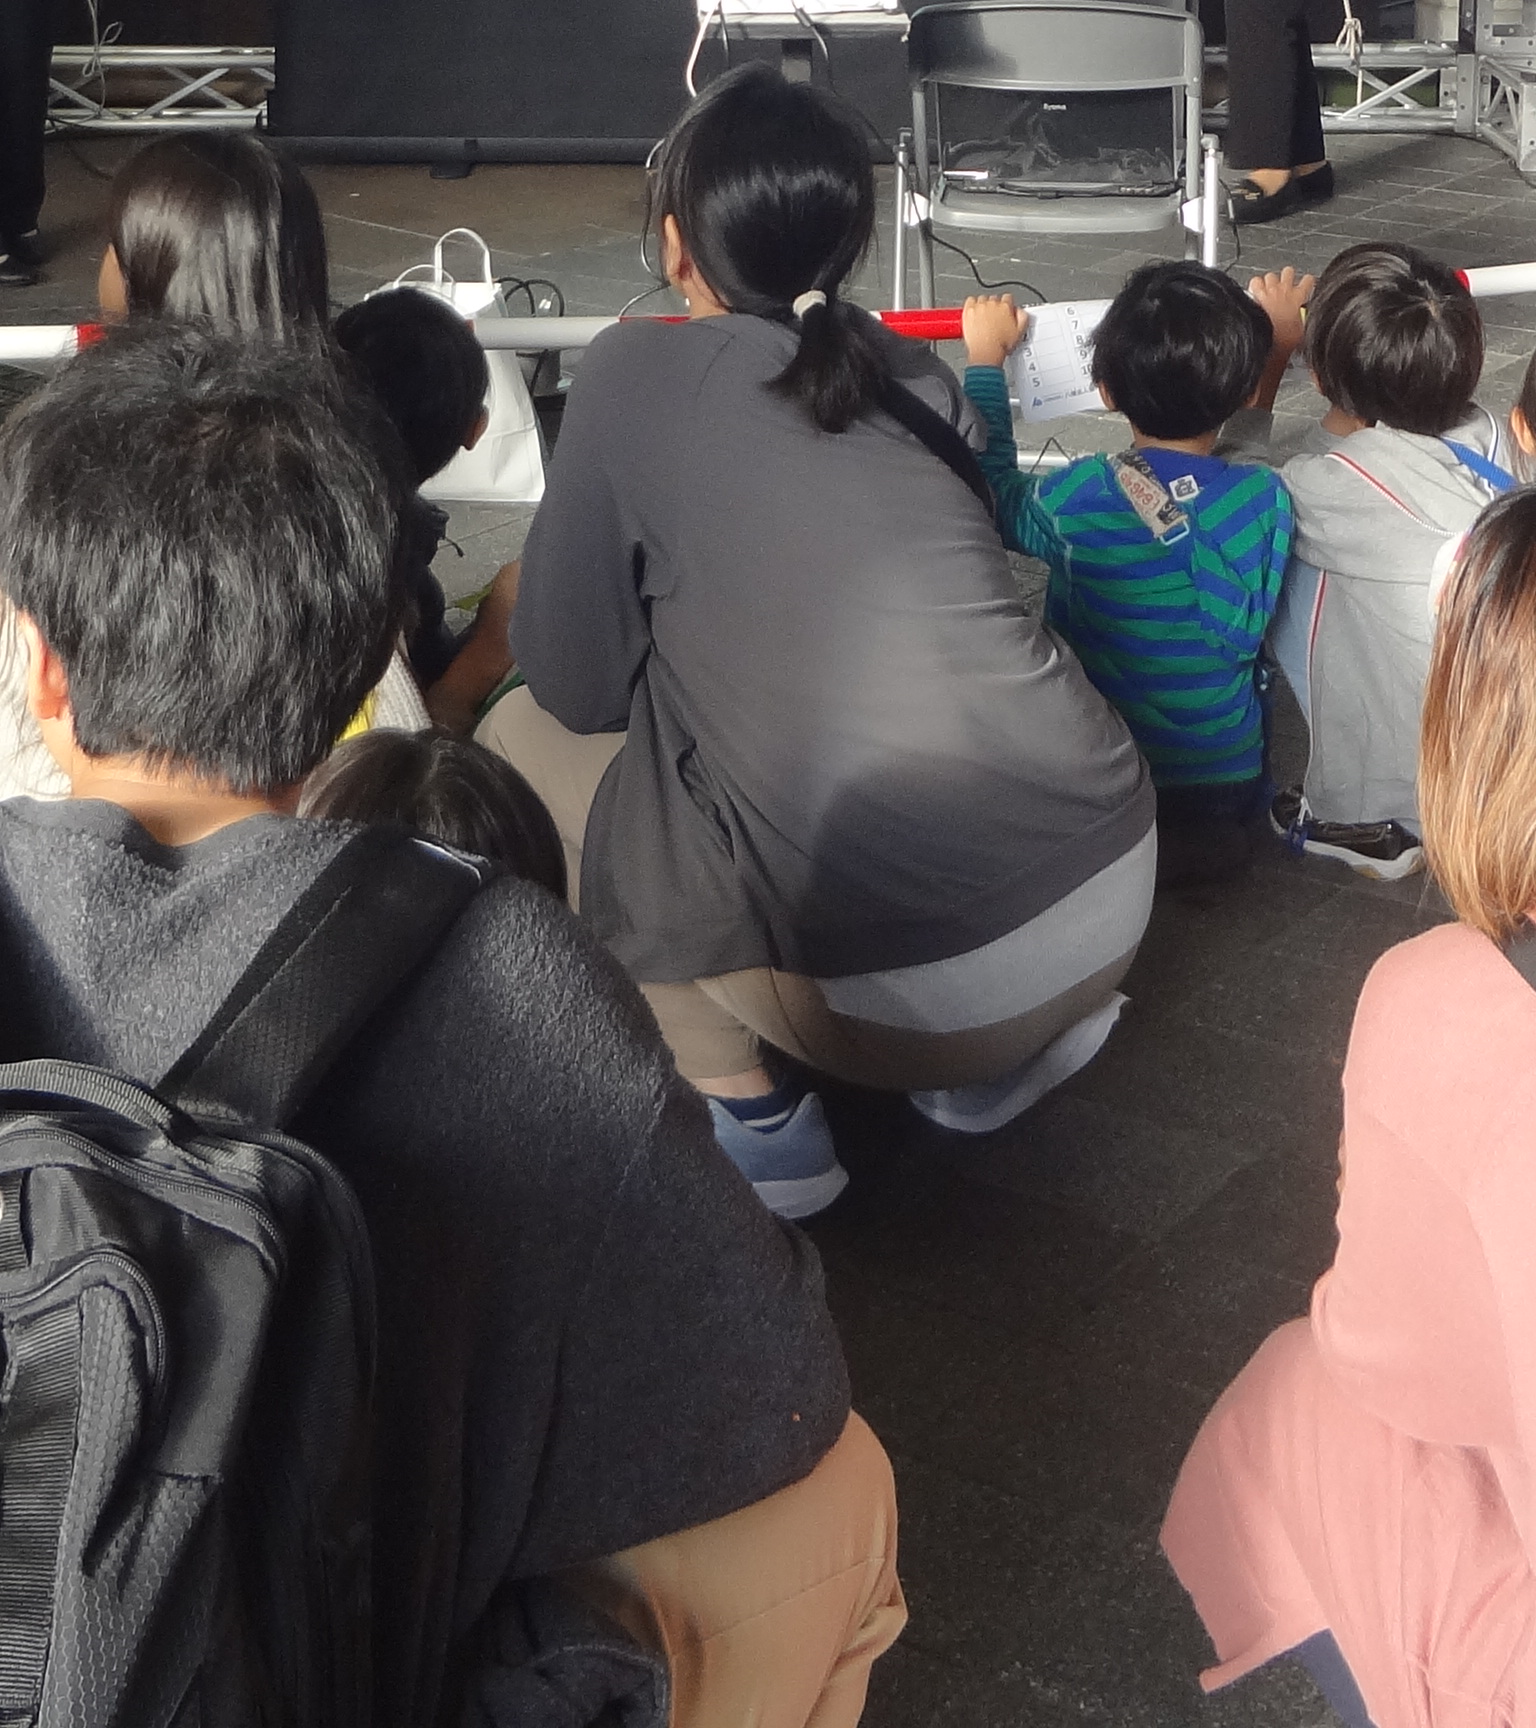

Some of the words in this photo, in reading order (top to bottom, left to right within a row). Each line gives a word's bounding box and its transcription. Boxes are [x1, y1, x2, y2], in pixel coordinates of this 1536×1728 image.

[1066, 306, 1076, 316] 6
[1071, 320, 1080, 330] 7
[1075, 335, 1084, 345] 8
[1024, 347, 1033, 357] 3
[1079, 349, 1088, 360] 9
[1028, 362, 1037, 372] 4
[1032, 377, 1041, 388] 5
